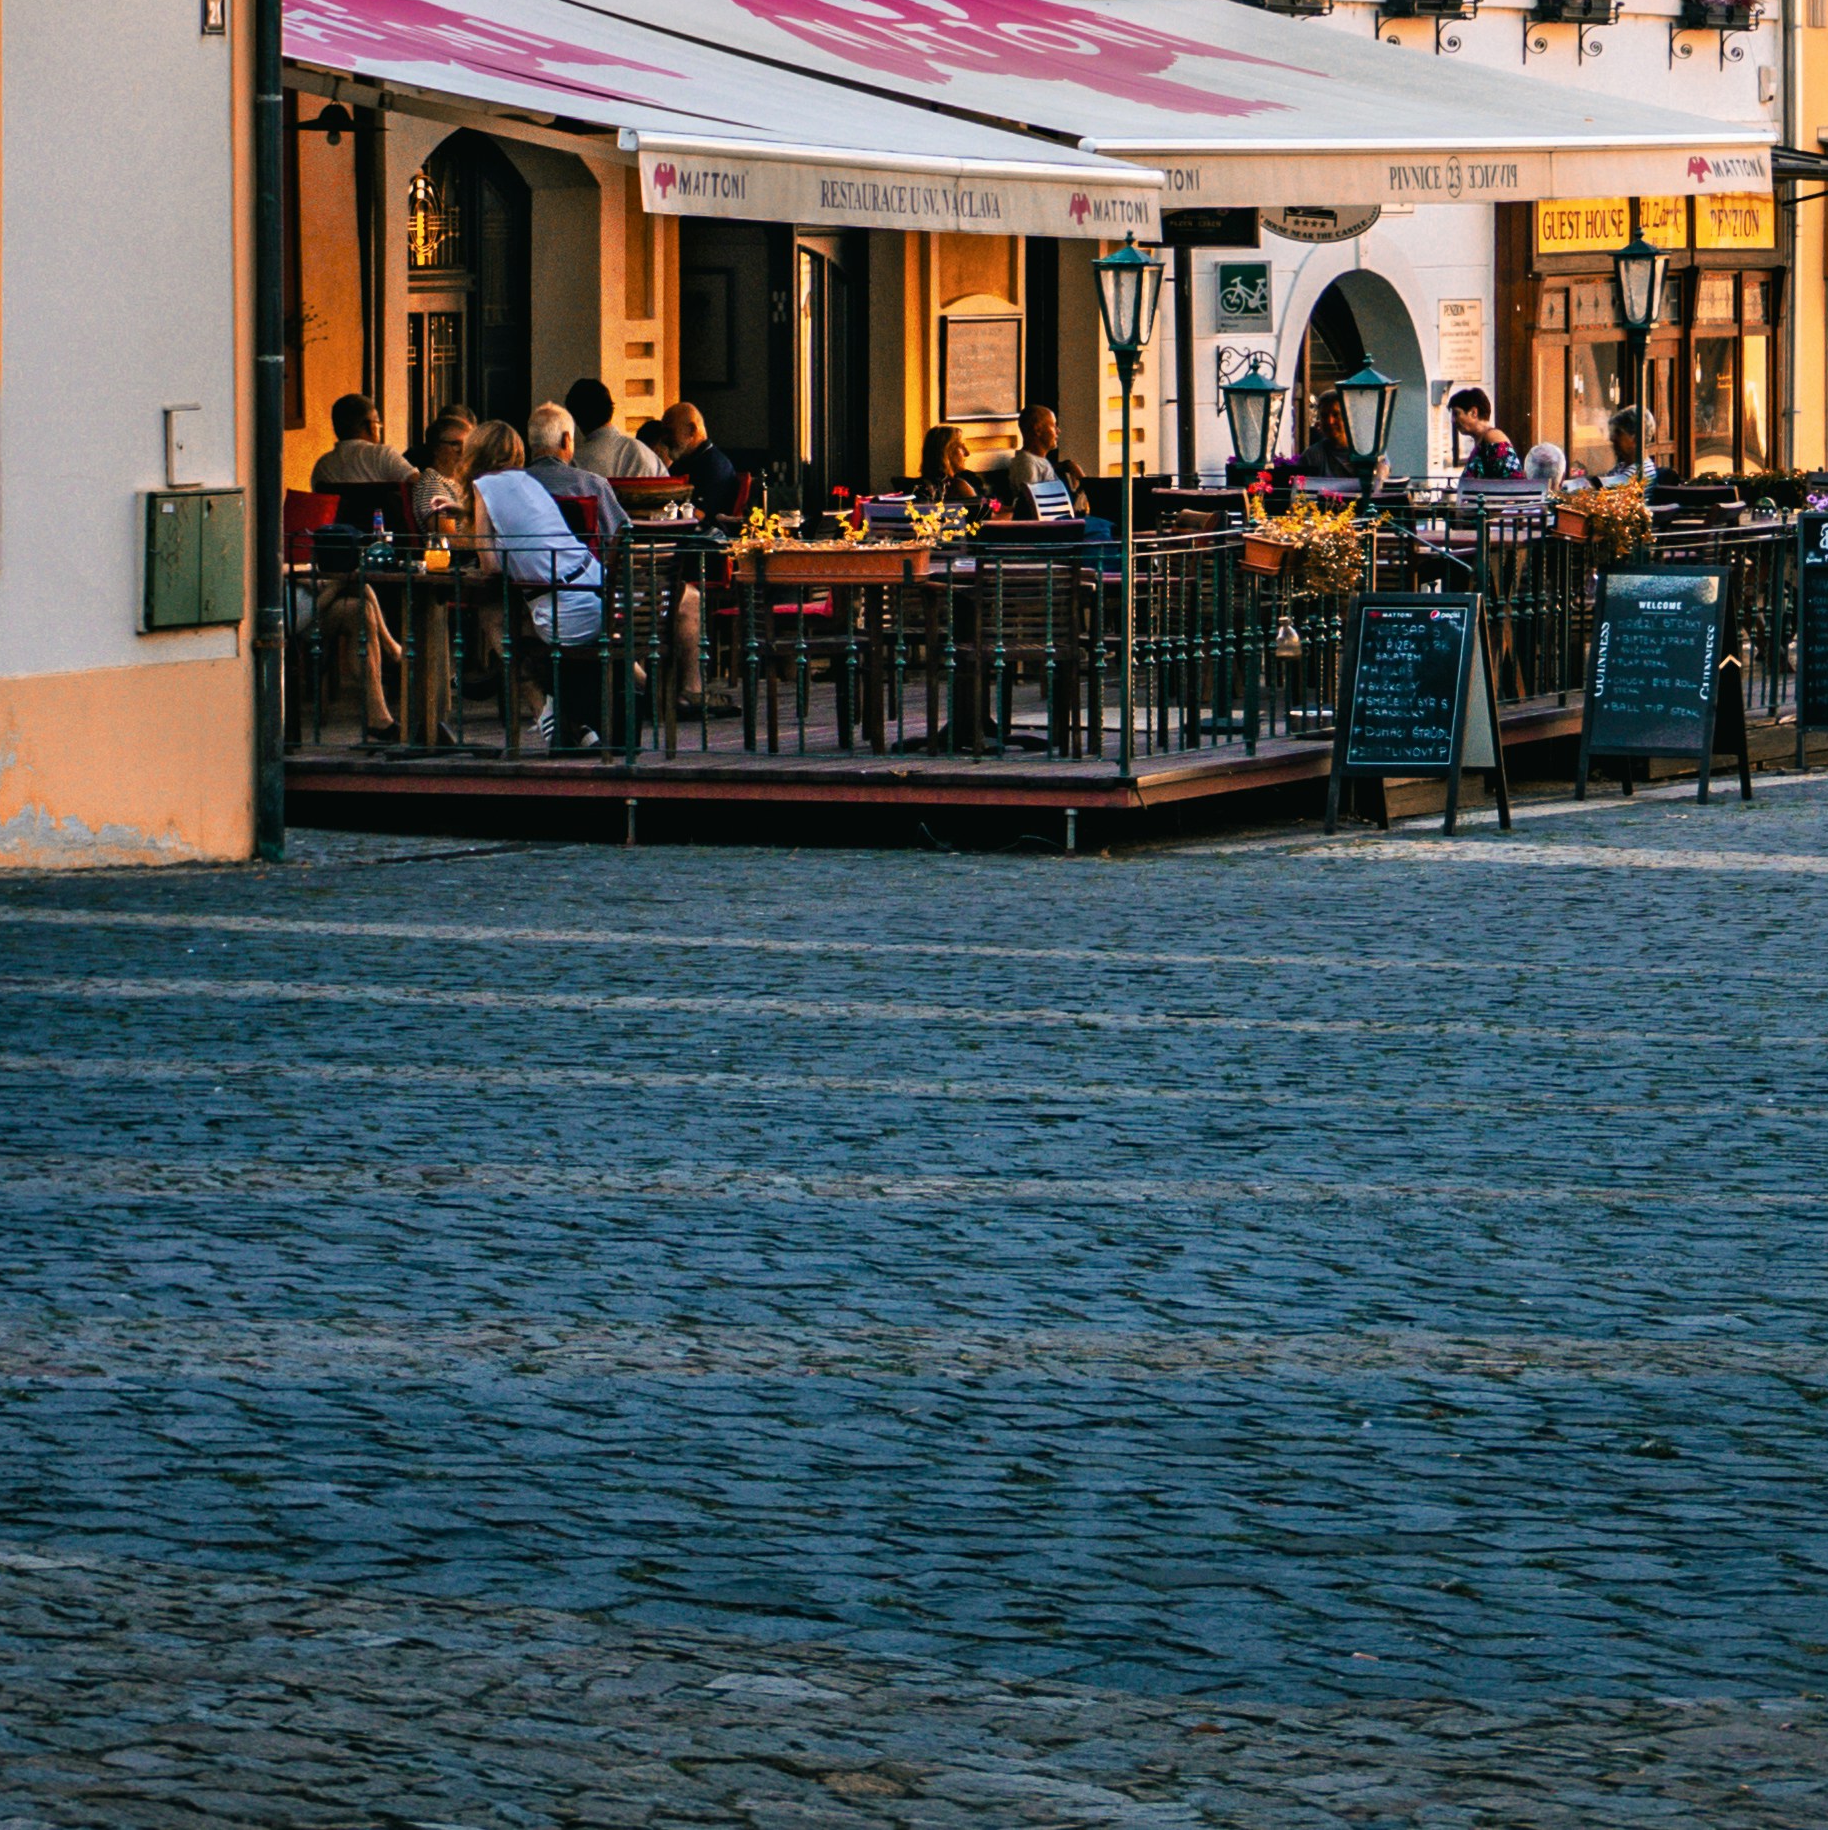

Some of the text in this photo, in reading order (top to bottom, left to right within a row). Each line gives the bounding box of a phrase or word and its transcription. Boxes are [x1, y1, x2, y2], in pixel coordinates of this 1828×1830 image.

[676, 170, 747, 200] MATTONI
[1166, 169, 1201, 191] TONI
[1389, 166, 1442, 190] PIVNICE
[820, 180, 907, 214] RESTAURACE
[910, 187, 921, 215] U
[923, 188, 940, 216] SV.
[1092, 197, 1150, 225] MATTONI
[1543, 209, 1624, 241] GUEST HOUSE
[1710, 209, 1760, 237] PENZION
[1638, 601, 1682, 610] WELCOME
[1594, 621, 1611, 697] GUINNESS
[1610, 701, 1640, 713] BALL
[1644, 704, 1665, 713] TIP
